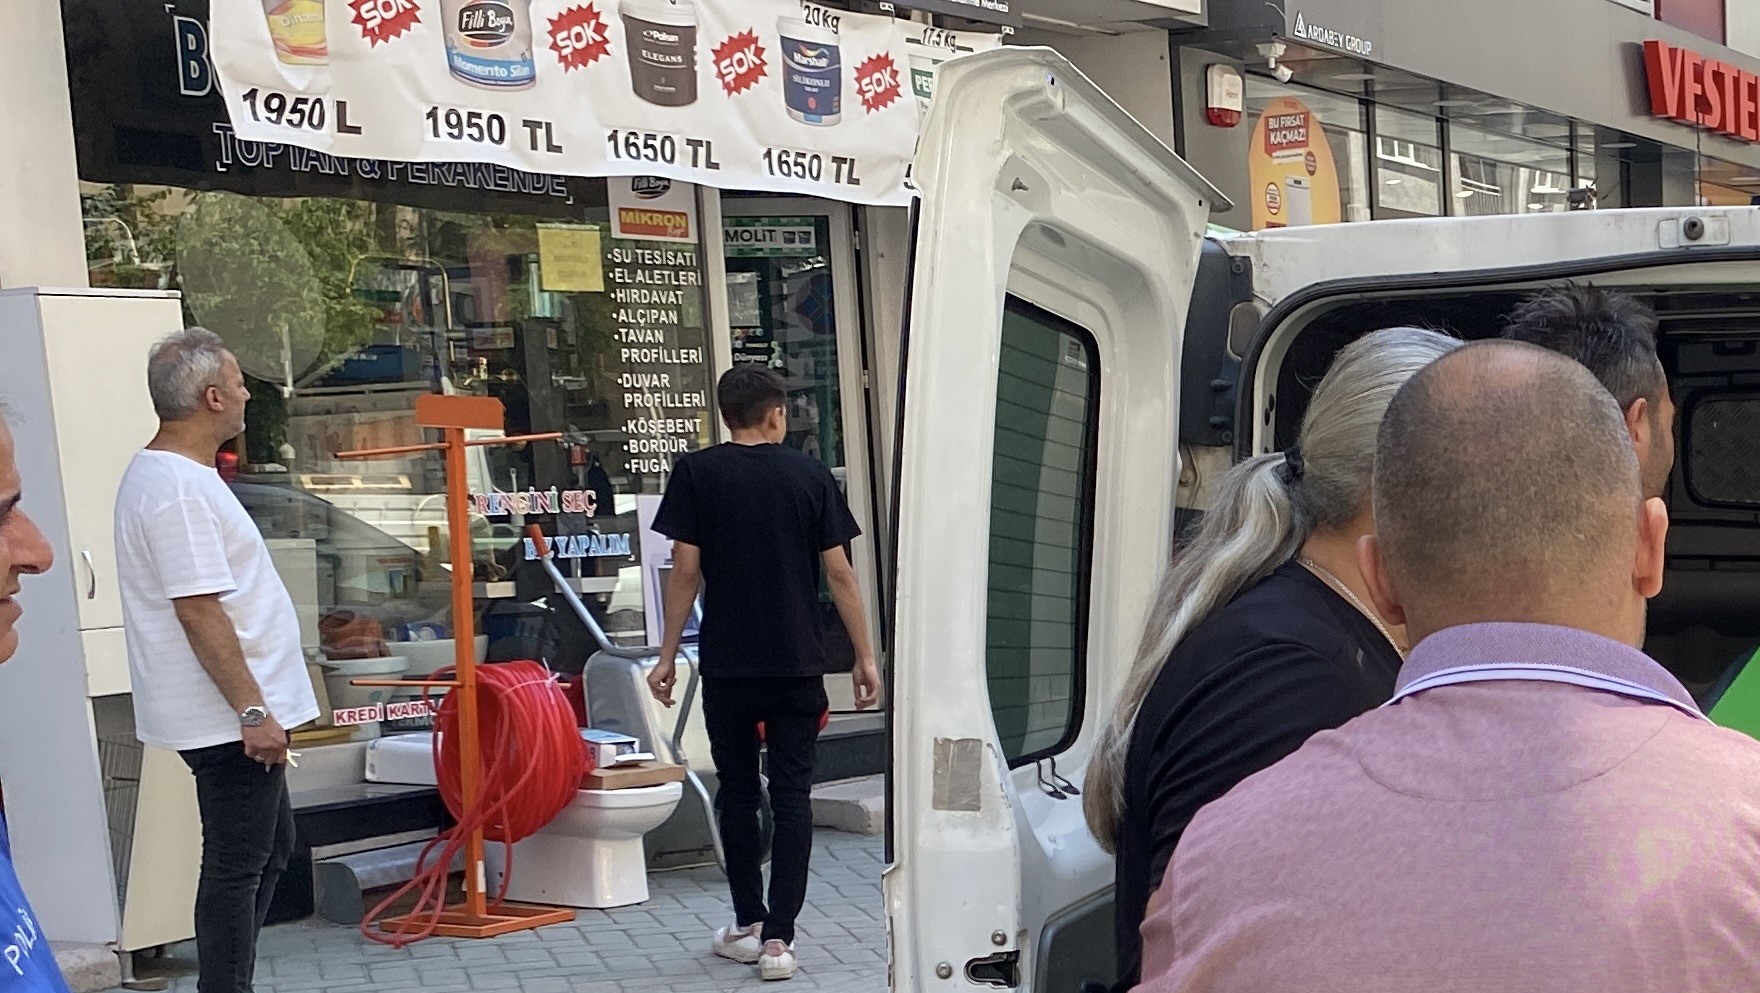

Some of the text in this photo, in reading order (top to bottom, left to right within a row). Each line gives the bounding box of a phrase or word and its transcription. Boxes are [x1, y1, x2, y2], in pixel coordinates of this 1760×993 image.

[461, 10, 485, 30] Filli
[803, 5, 841, 34] 20 kg
[556, 19, 604, 62] ŞOK
[1307, 24, 1372, 55] ARDABEY GROUP
[641, 49, 683, 63] ELEGANS
[719, 44, 762, 87] ŞOK
[860, 66, 897, 105] ŞOK
[242, 87, 326, 131] 1950
[425, 105, 563, 154] 1950 TL
[1268, 113, 1305, 129] BU FIRSAT
[1269, 127, 1307, 147] KAÇMAZ!
[607, 129, 720, 170] 1650 TL
[763, 147, 861, 186] 1650 TL
[620, 208, 687, 228] MİKRON
[613, 248, 697, 266] SU TESİSATI
[614, 270, 702, 286] EL ALETLERİ
[616, 289, 684, 305] HIRDAVAT
[618, 309, 678, 326] ALÇIPAN
[619, 328, 664, 343] TAVAN
[621, 345, 703, 363] PROFİLLERİ
[622, 373, 670, 388] DUVAR
[624, 390, 705, 408] PROFİLLERİ
[627, 416, 702, 436] KÖŞEBENT
[629, 436, 688, 453] BORDÜR
[630, 458, 670, 473] FUGA
[474, 485, 597, 518] RENGİNİ SEÇ
[555, 533, 631, 559] YAPALIM
[333, 702, 384, 727] KREDİ
